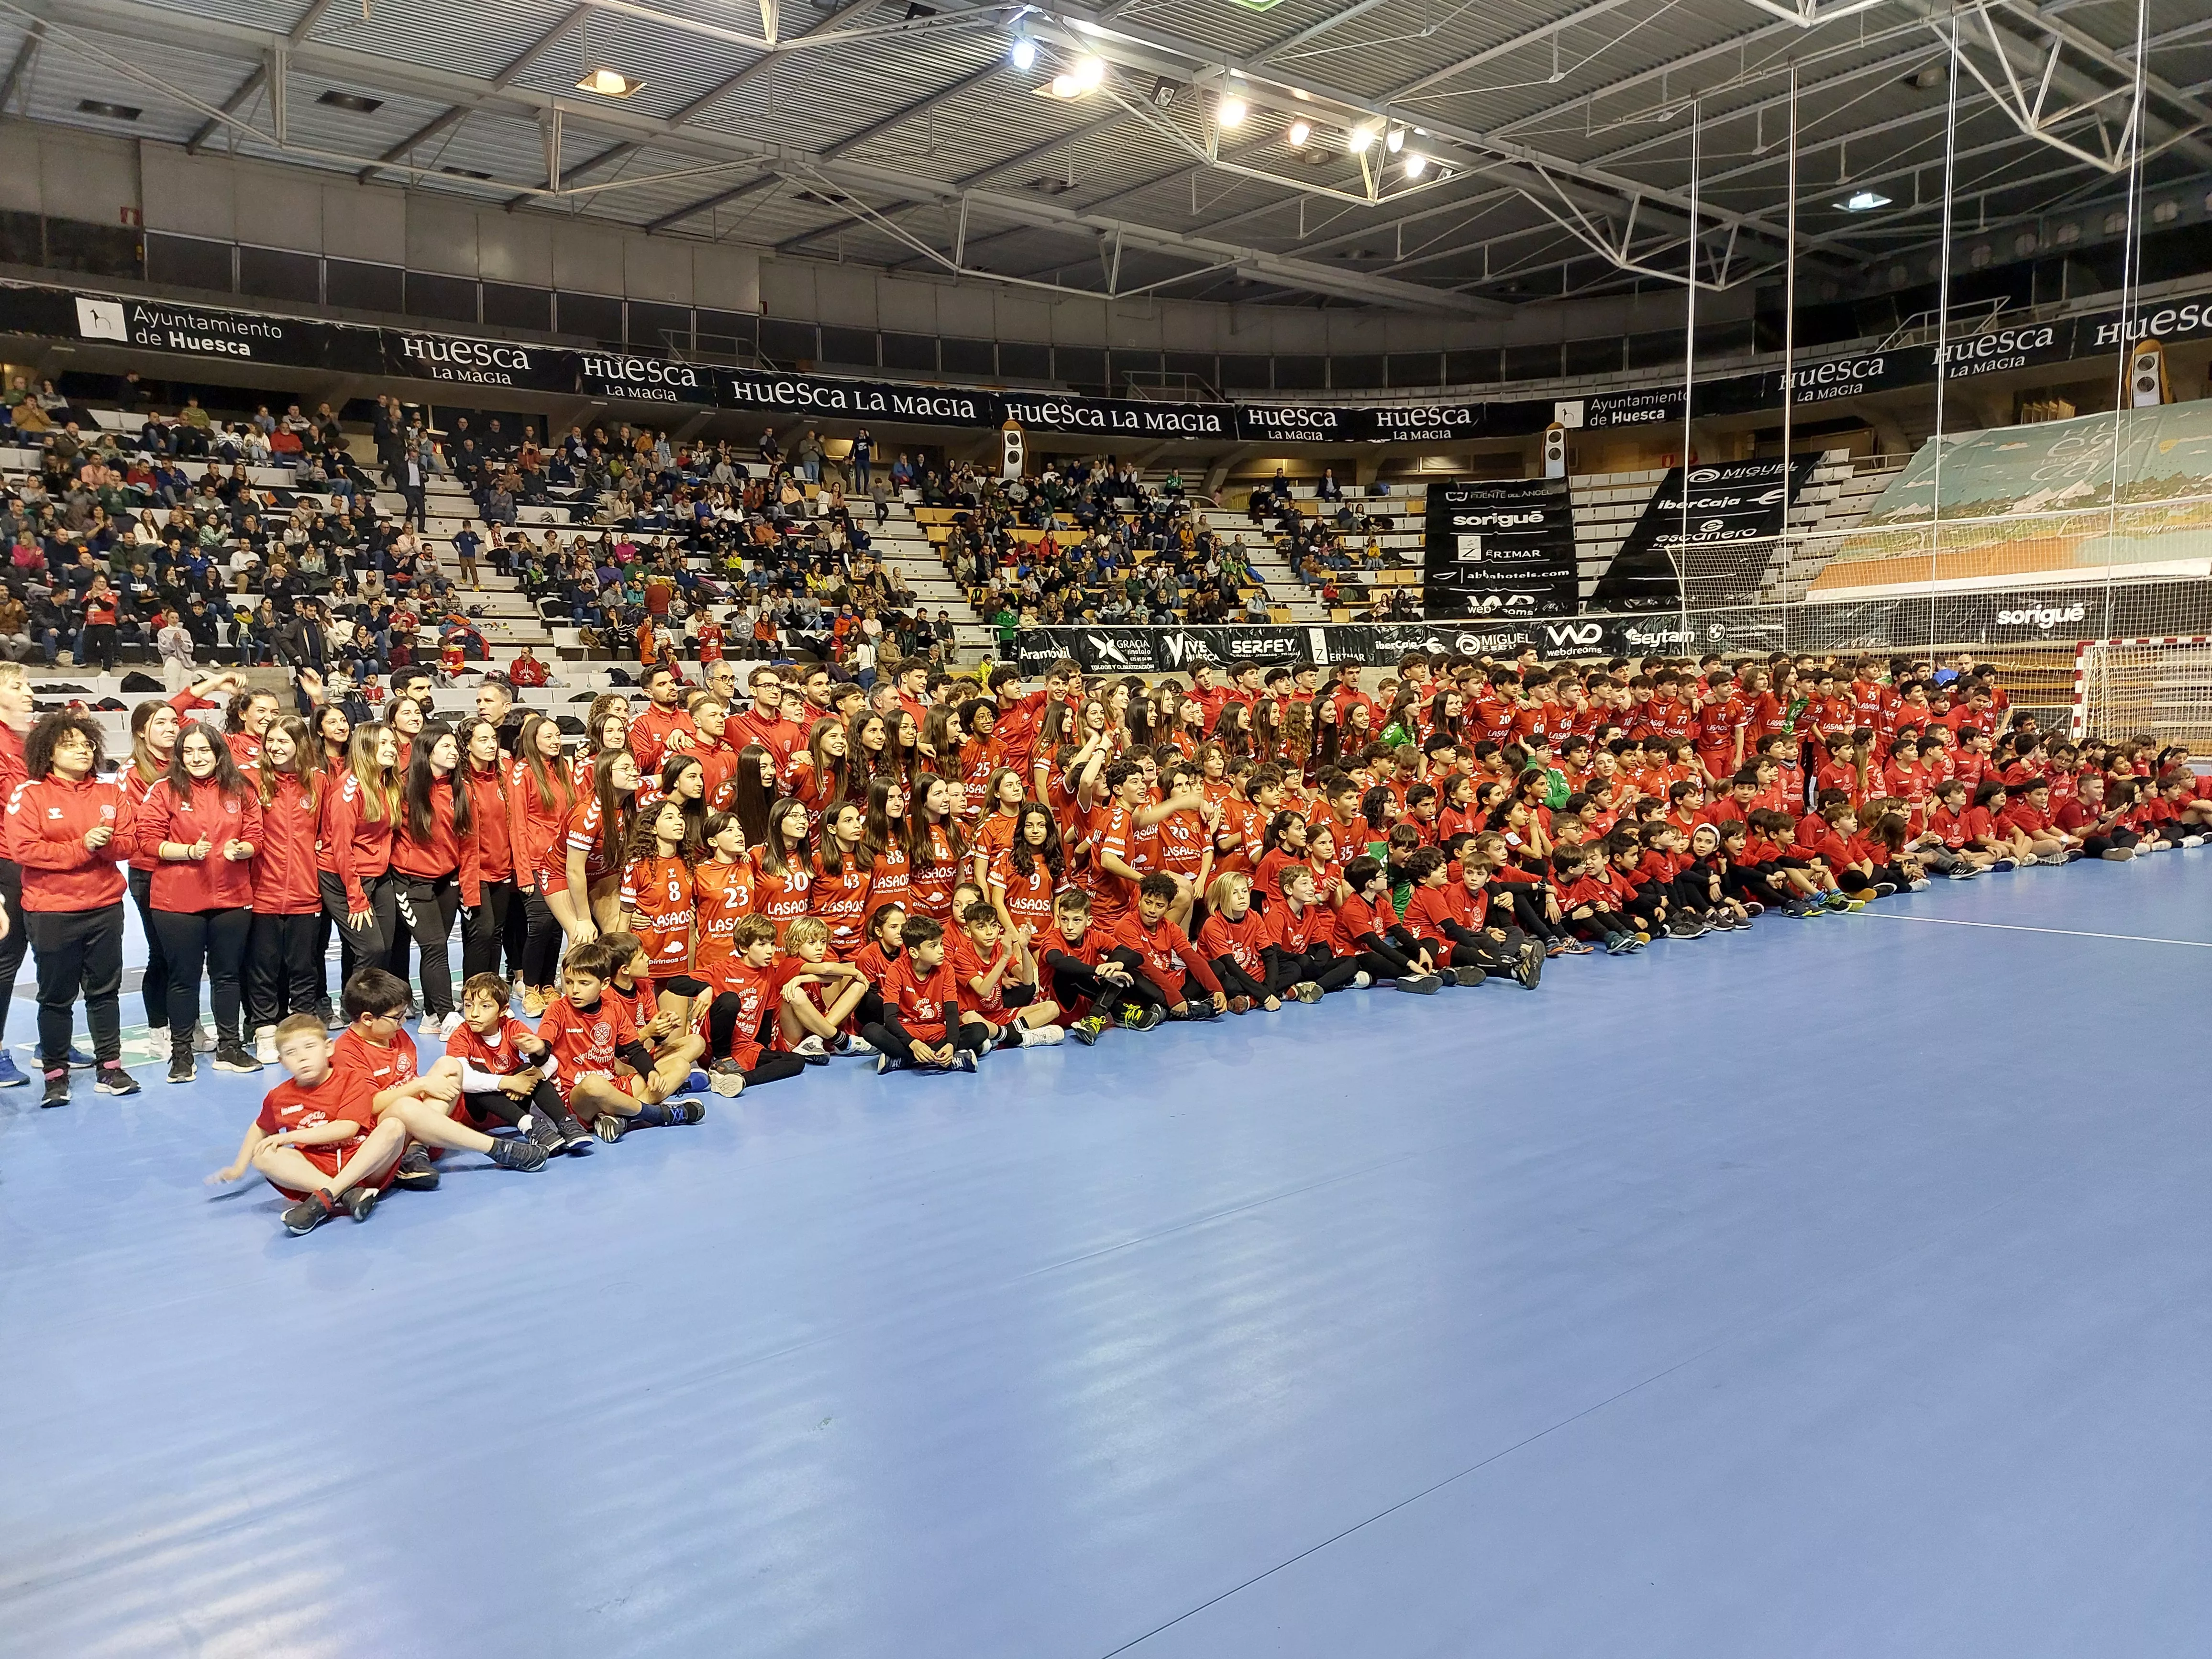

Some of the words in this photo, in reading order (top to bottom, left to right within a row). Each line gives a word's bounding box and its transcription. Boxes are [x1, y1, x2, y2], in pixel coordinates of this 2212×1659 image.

[133, 305, 282, 339] Ayuntamiento
[135, 327, 162, 346] de
[169, 330, 251, 357] Huesca
[1590, 414, 1607, 426] de
[1612, 408, 1665, 423] Huesca
[1656, 528, 1757, 542] escanero
[1117, 640, 1150, 648] GRACIA
[1482, 632, 1533, 645] MIGUEL
[1020, 646, 1071, 660] Aramóvil
[1231, 639, 1295, 654] SERFEY
[1547, 646, 1602, 657] webdreams
[1499, 715, 1511, 725] 20
[1560, 719, 1572, 730] 69
[1533, 722, 1545, 734] 60
[972, 762, 991, 777] 25
[1659, 785, 1666, 797] 7
[935, 842, 949, 860] 4
[784, 871, 808, 893] 30
[843, 874, 860, 889] 43
[1029, 873, 1041, 891] 9
[668, 881, 681, 902] 8
[723, 885, 749, 909] 23
